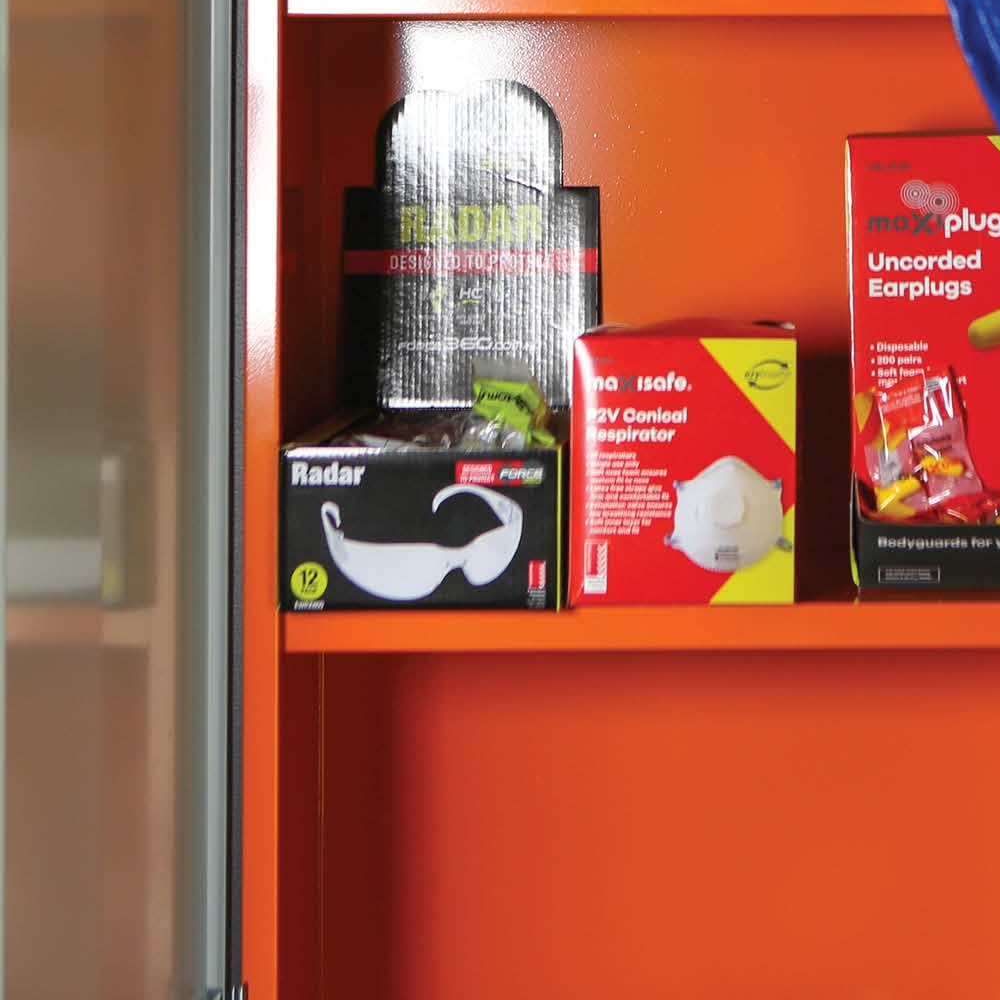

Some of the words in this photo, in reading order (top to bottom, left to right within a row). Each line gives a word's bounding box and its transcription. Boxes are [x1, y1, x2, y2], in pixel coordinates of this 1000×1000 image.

[400, 204, 542, 243] RADAR
[488, 252, 554, 271] PROT
[868, 249, 981, 272] Uncorded
[868, 276, 973, 301] Earplugs
[876, 341, 929, 353] Disposable
[877, 355, 895, 366] 200
[897, 354, 923, 367] pairs
[877, 367, 898, 378] Soft
[622, 406, 688, 424] Conical
[586, 425, 676, 445] Respirator
[291, 461, 365, 486] Radar
[877, 536, 968, 551] Bodyguards
[971, 536, 993, 549] for
[300, 567, 318, 587] 12
